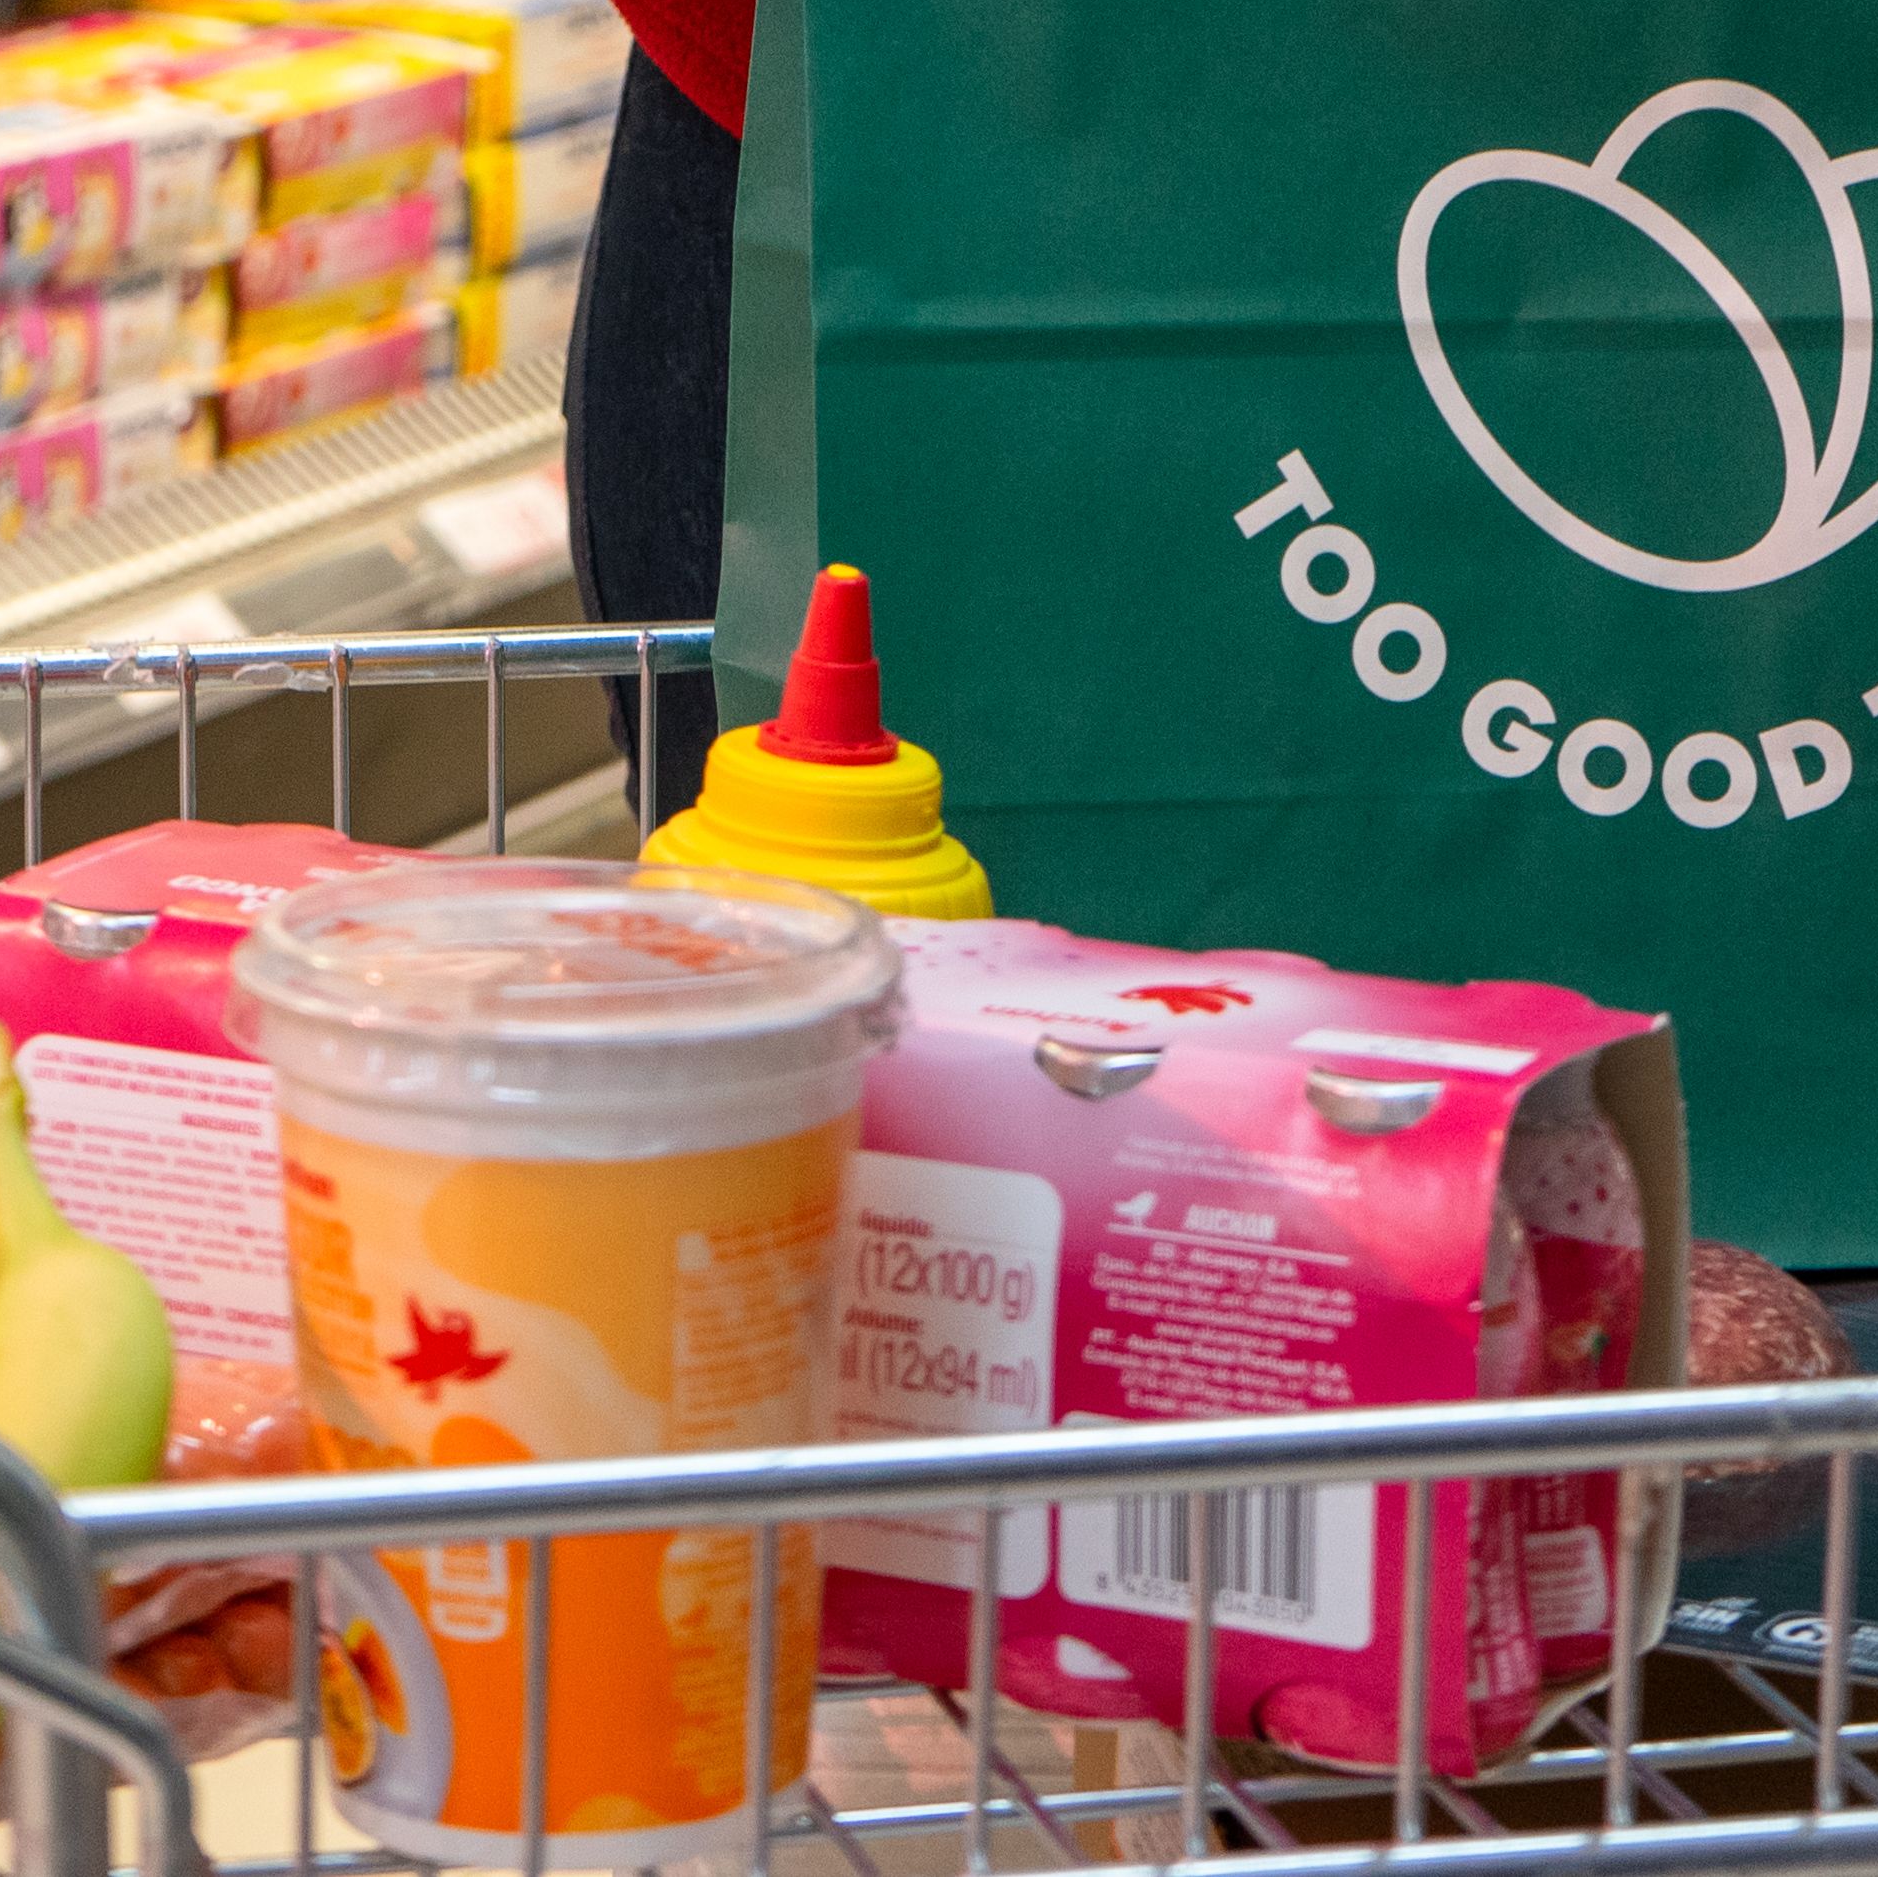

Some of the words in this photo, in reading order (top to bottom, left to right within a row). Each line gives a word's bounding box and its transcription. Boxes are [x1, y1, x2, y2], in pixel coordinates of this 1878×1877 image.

[1233, 448, 1447, 703] TOO
[1461, 678, 1853, 829] GOOD
[1184, 1204, 1277, 1242] AUCHAN
